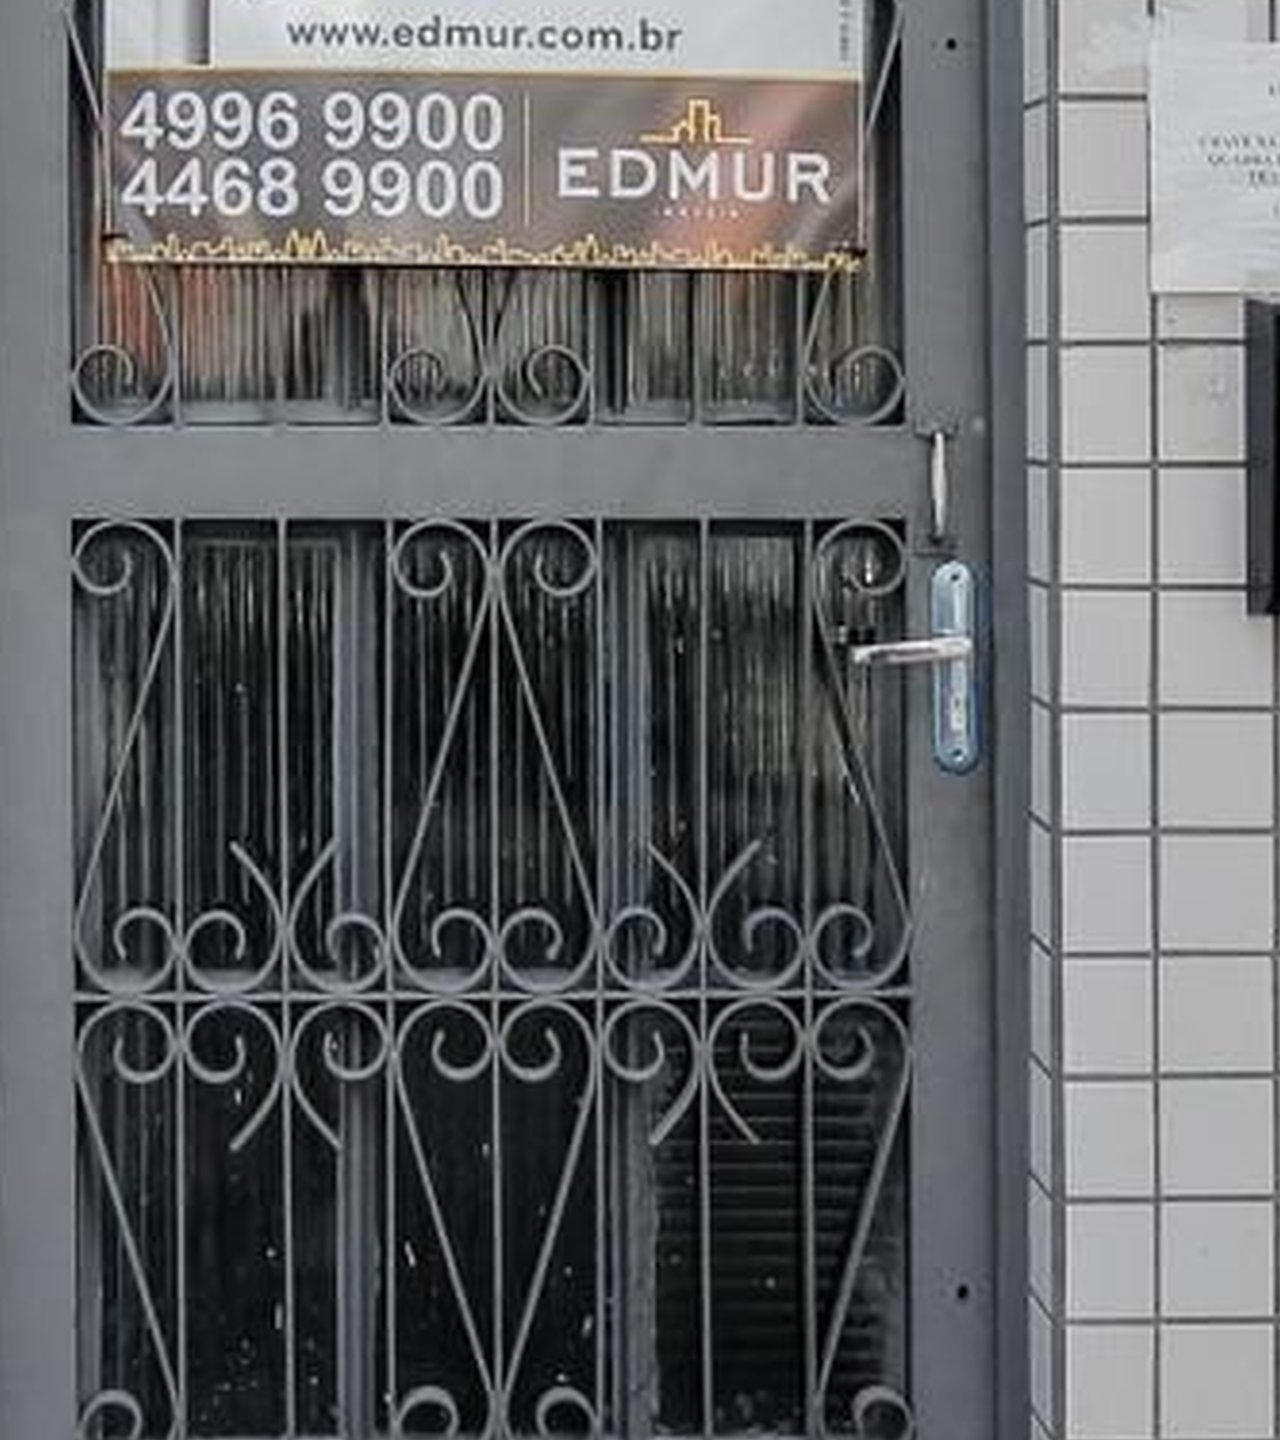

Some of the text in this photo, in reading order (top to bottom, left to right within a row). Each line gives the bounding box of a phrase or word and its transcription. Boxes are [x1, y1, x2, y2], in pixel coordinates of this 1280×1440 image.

[286, 14, 684, 55] www.edmur.com.br
[120, 89, 503, 151] 4996 9900
[120, 158, 504, 219] 4468 9900
[556, 147, 833, 205] EDMUR
